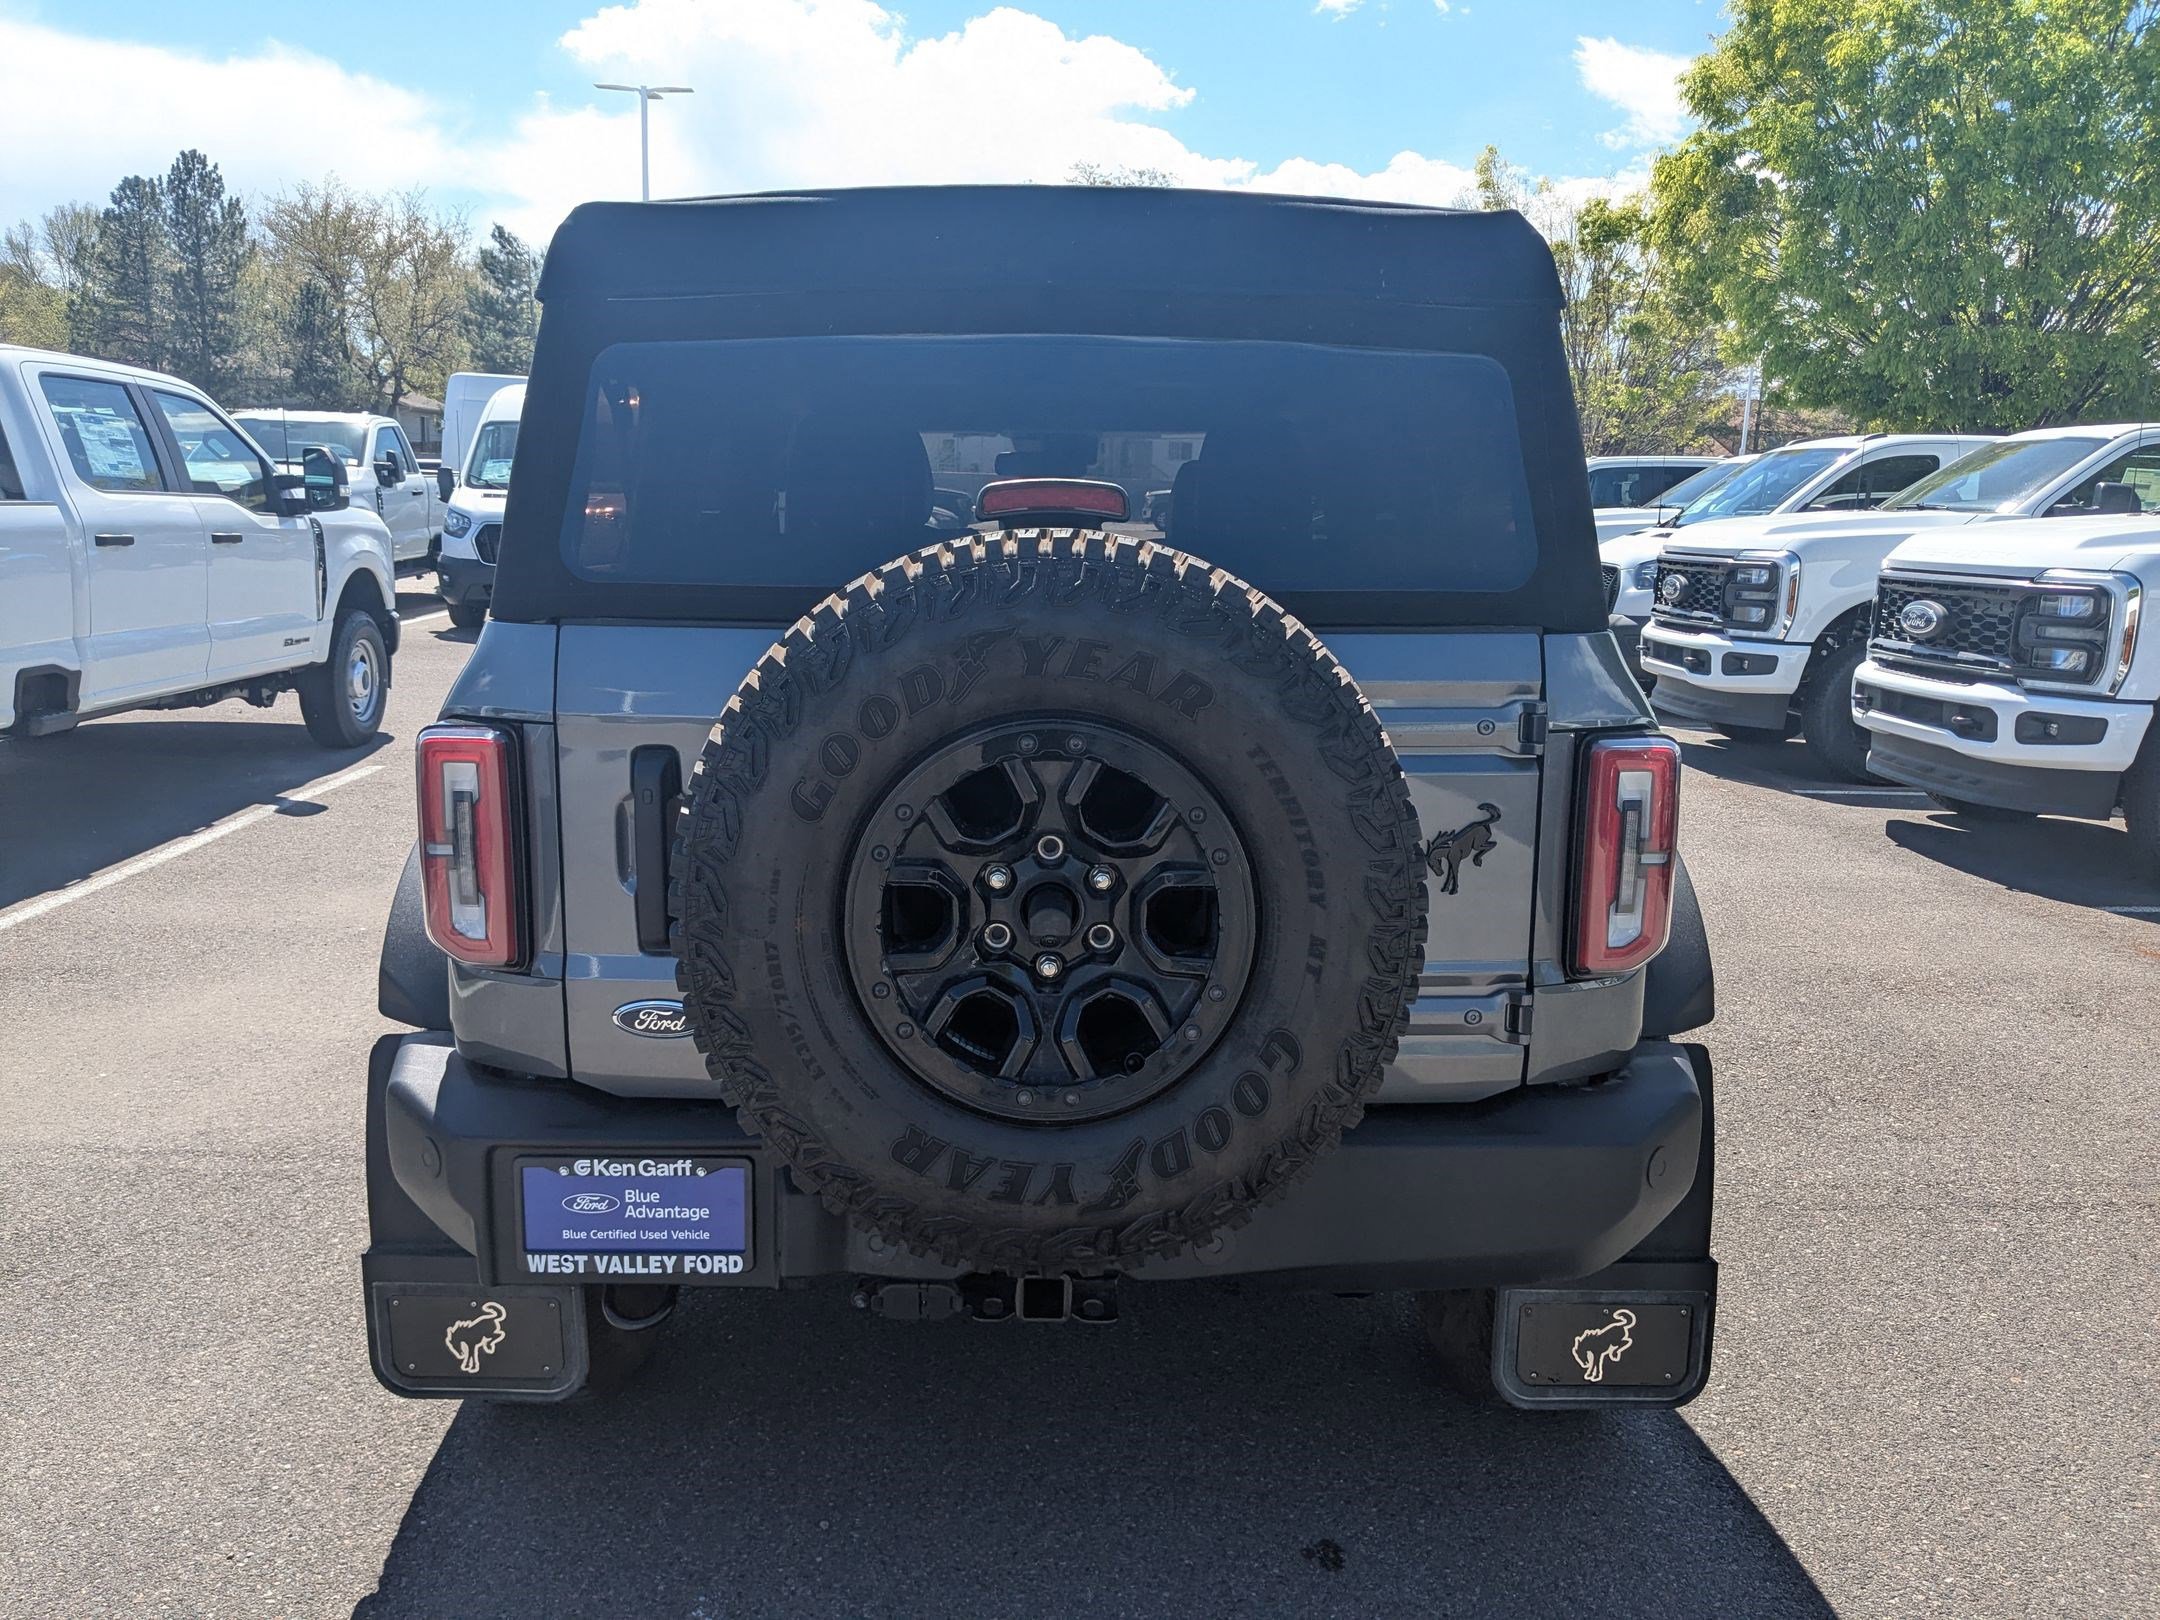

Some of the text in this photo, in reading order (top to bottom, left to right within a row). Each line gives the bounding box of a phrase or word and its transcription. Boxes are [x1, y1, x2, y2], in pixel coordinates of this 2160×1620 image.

[1906, 611, 1928, 628] Ford
[634, 1009, 687, 1031] Ford
[594, 1159, 692, 1177] Ken Garff
[572, 1195, 609, 1211] Ford
[624, 1189, 660, 1203] Blue
[624, 1205, 710, 1221] Advantage
[562, 1229, 710, 1240] Blue Certified Used Vehicle
[526, 1254, 744, 1274] WEST VALLEY FORD
